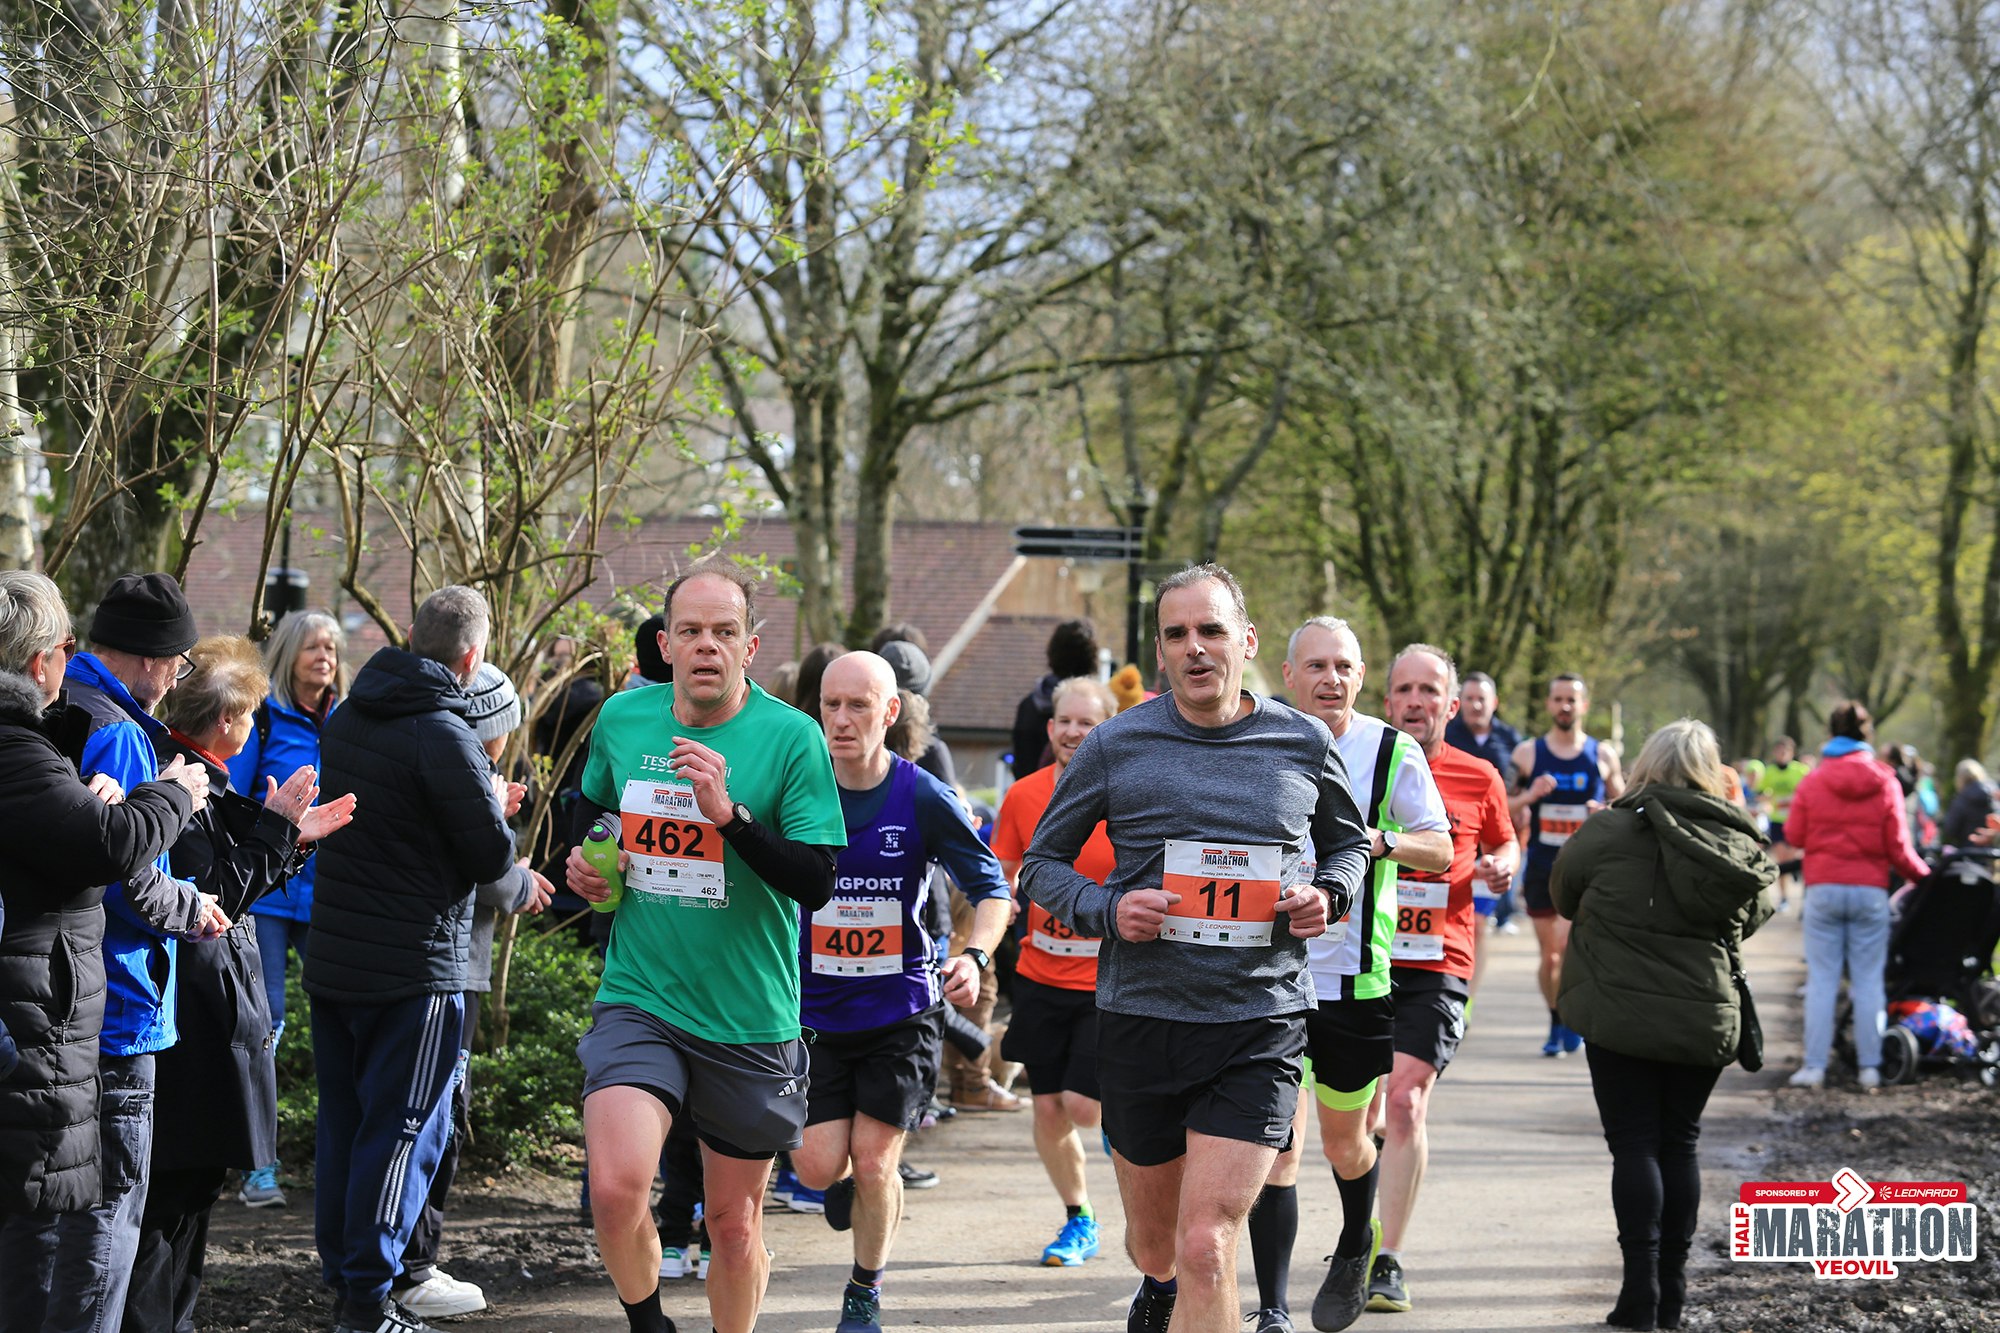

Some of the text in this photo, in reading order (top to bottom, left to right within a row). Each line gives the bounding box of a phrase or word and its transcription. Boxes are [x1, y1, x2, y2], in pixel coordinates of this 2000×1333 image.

[467, 692, 504, 714] AND
[641, 754, 677, 768] TESC
[654, 794, 693, 808] MARATHON
[877, 825, 907, 833] LANGPORT
[635, 818, 704, 857] 462
[655, 861, 689, 869] LEONARDO
[1204, 854, 1249, 867] MARATHON
[834, 877, 904, 891] GPORT
[701, 887, 718, 896] 462
[1199, 881, 1240, 918] 11
[1043, 915, 1084, 939] 45
[1204, 923, 1241, 931] LEONARDO
[1397, 907, 1432, 933] 86
[825, 929, 886, 957] 402
